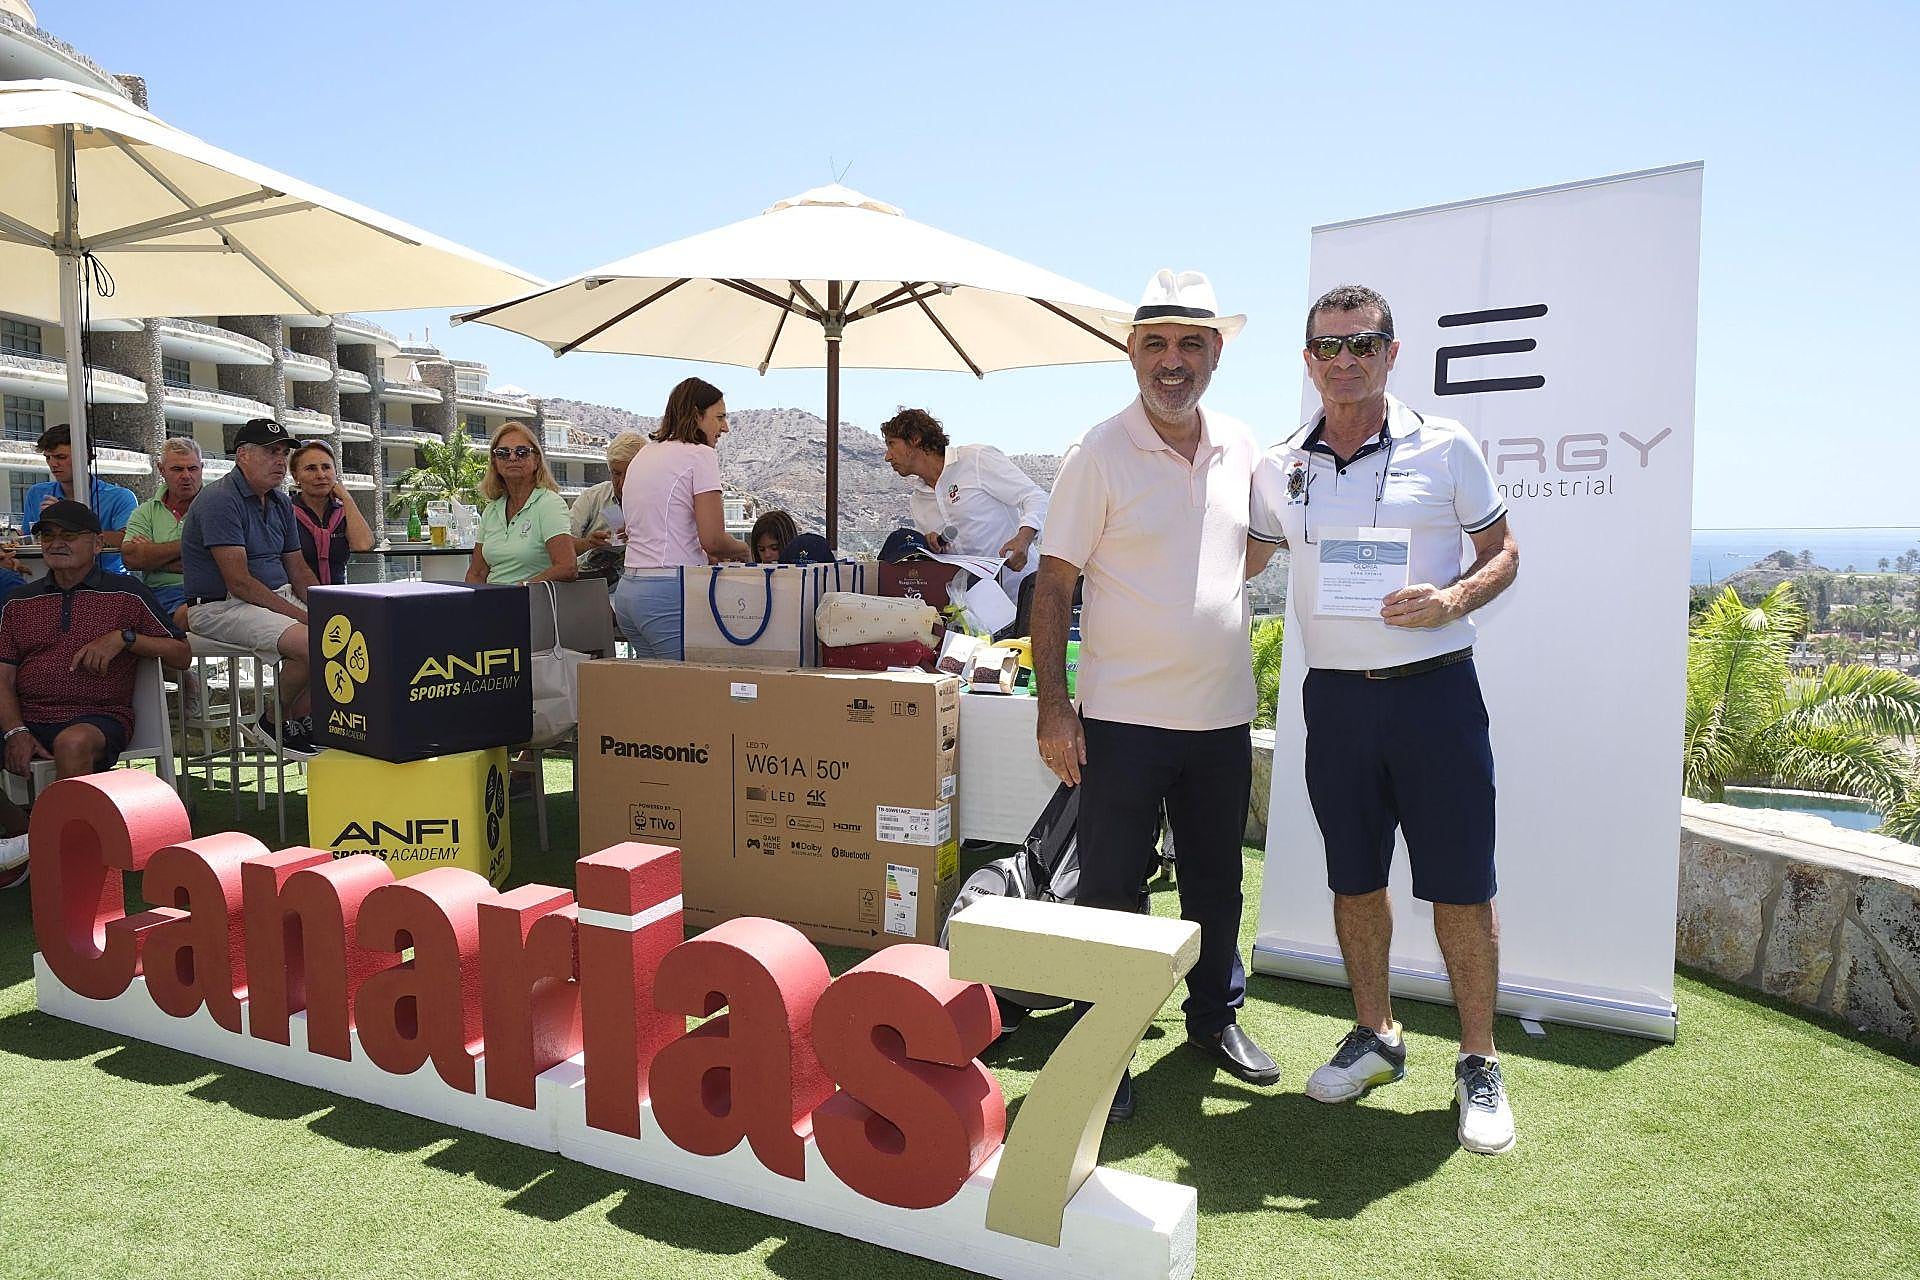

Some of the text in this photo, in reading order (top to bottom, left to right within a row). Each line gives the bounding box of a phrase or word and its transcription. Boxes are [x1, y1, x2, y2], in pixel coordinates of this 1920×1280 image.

[1482, 427, 1673, 476] RGY
[1497, 475, 1615, 499] ndustrial
[409, 648, 520, 685] ANFI
[409, 675, 520, 702] SPORTS ACADEMY
[328, 709, 366, 732] ANFI
[600, 735, 709, 764] Panasonic
[746, 741, 769, 750] LED TV
[746, 753, 850, 781] W61A 50"
[771, 789, 827, 803] LED 4K
[330, 819, 460, 848] ANFI
[649, 817, 676, 831] TiVo
[762, 834, 781, 843] GAME
[763, 840, 781, 849] MODE
[801, 842, 822, 853] Dolby
[390, 846, 460, 861] ACADEMY
[840, 849, 870, 860] Bluetooth
